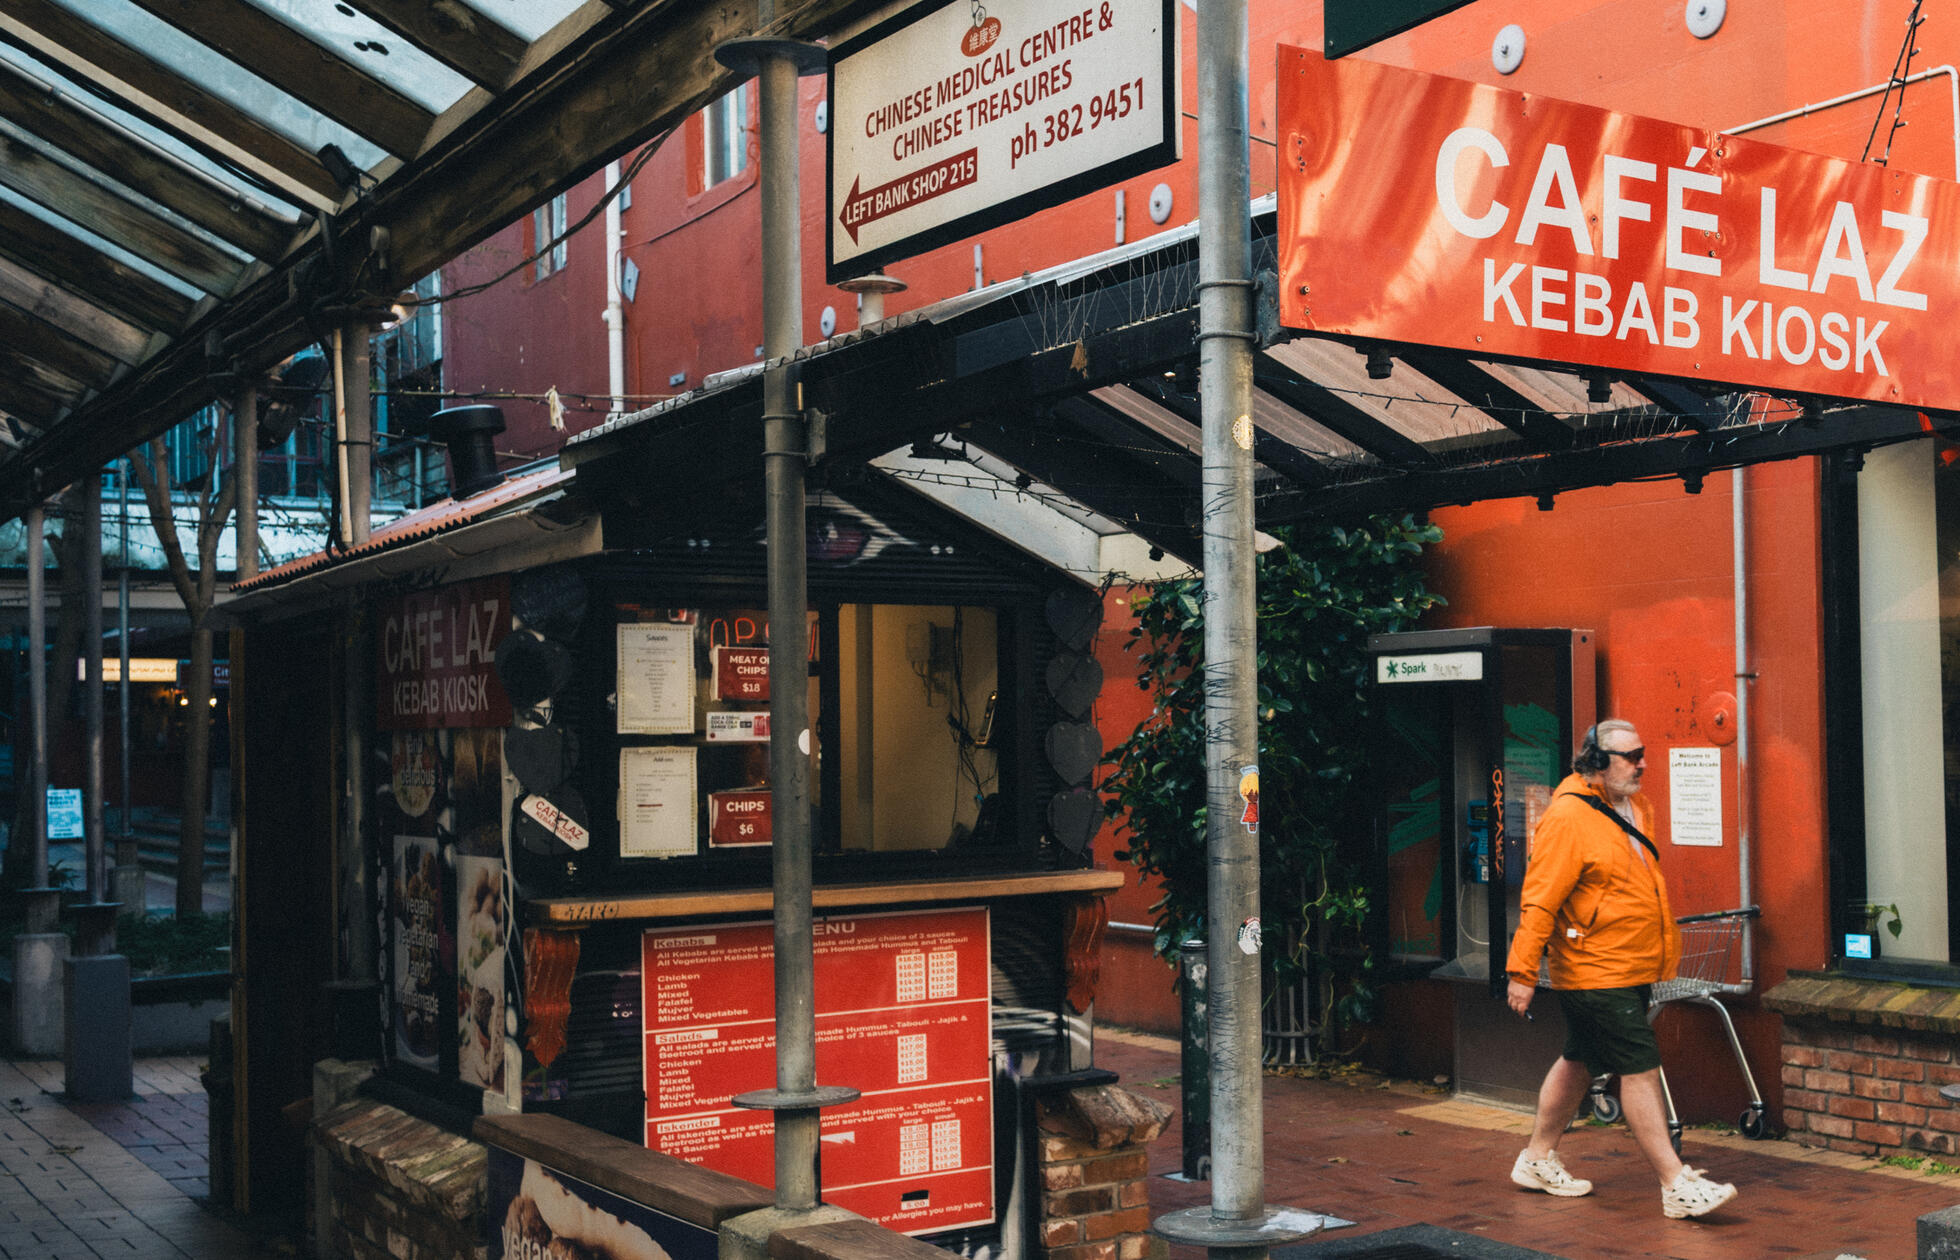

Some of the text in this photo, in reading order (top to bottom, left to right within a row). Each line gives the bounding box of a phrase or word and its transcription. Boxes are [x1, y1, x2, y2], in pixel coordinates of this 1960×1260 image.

[865, 3, 1113, 138] CHINESE MEDICAL CENTRE &
[893, 60, 1073, 161] CHINESE TREASURES
[1011, 77, 1144, 169] ph 382 9451
[846, 156, 975, 225] LEFT BANK SHOP 215
[1435, 127, 1928, 311] CAFÉ LAZ
[1483, 257, 1889, 376] KEBAB KIOSK
[385, 598, 499, 673] CAFÉ LAZ
[729, 655, 756, 664] MEAT
[736, 666, 767, 675] CHIPS
[1401, 662, 1427, 676] Spark
[393, 674, 489, 715] KEBAB KIOSK
[742, 683, 761, 693] $18
[726, 801, 765, 812] CHIPS
[562, 821, 584, 841] LAZ
[739, 823, 754, 835] $6
[813, 922, 855, 936] ENU
[656, 938, 705, 948] Kebabs
[831, 943, 879, 952] Homemade
[881, 940, 918, 949] Hummus
[939, 936, 968, 945] Tabouli
[857, 937, 877, 945] your
[878, 933, 907, 941] choice
[673, 949, 708, 958] Kebabs
[727, 945, 758, 953] served
[673, 956, 722, 966] Vegetarian
[724, 953, 758, 961] Kebabs
[657, 974, 700, 982] Chicken
[658, 982, 687, 991] Lamb
[658, 990, 689, 999] Mixed
[658, 998, 693, 1007] Falafel
[658, 1006, 694, 1015] Mujver
[658, 1009, 749, 1023] Mixed Vegetables
[846, 1023, 888, 1033] Hummus
[896, 1019, 929, 1028] Tabouli
[659, 1032, 703, 1043] Salads
[867, 1029, 900, 1037] sauces
[659, 1045, 673, 1053] All
[676, 1042, 709, 1051] salads
[731, 1036, 765, 1045] served
[659, 1049, 704, 1059] Beetroot
[728, 1043, 762, 1052] served
[659, 1059, 702, 1069] Chicken
[659, 1069, 689, 1077] Lamb
[659, 1076, 691, 1085] Mixed
[659, 1084, 695, 1093] Falafel
[659, 1092, 695, 1102] Mujver
[660, 1094, 738, 1109] Mixed Vegeta
[820, 1111, 860, 1121] memade
[862, 1106, 904, 1116] Hummus
[912, 1101, 946, 1110] Tabouli
[842, 1116, 874, 1125] served
[876, 1112, 896, 1120] with
[898, 1110, 919, 1118] your
[921, 1107, 952, 1115] choice
[903, 1117, 924, 1125] large
[660, 1134, 674, 1142] All
[748, 1122, 775, 1130] serve
[660, 1138, 705, 1148] Beetroot
[722, 1132, 742, 1140] well
[683, 1143, 720, 1152] Sauces
[892, 1210, 927, 1220] Allergies
[929, 1208, 944, 1216] you
[946, 1204, 962, 1213] may
